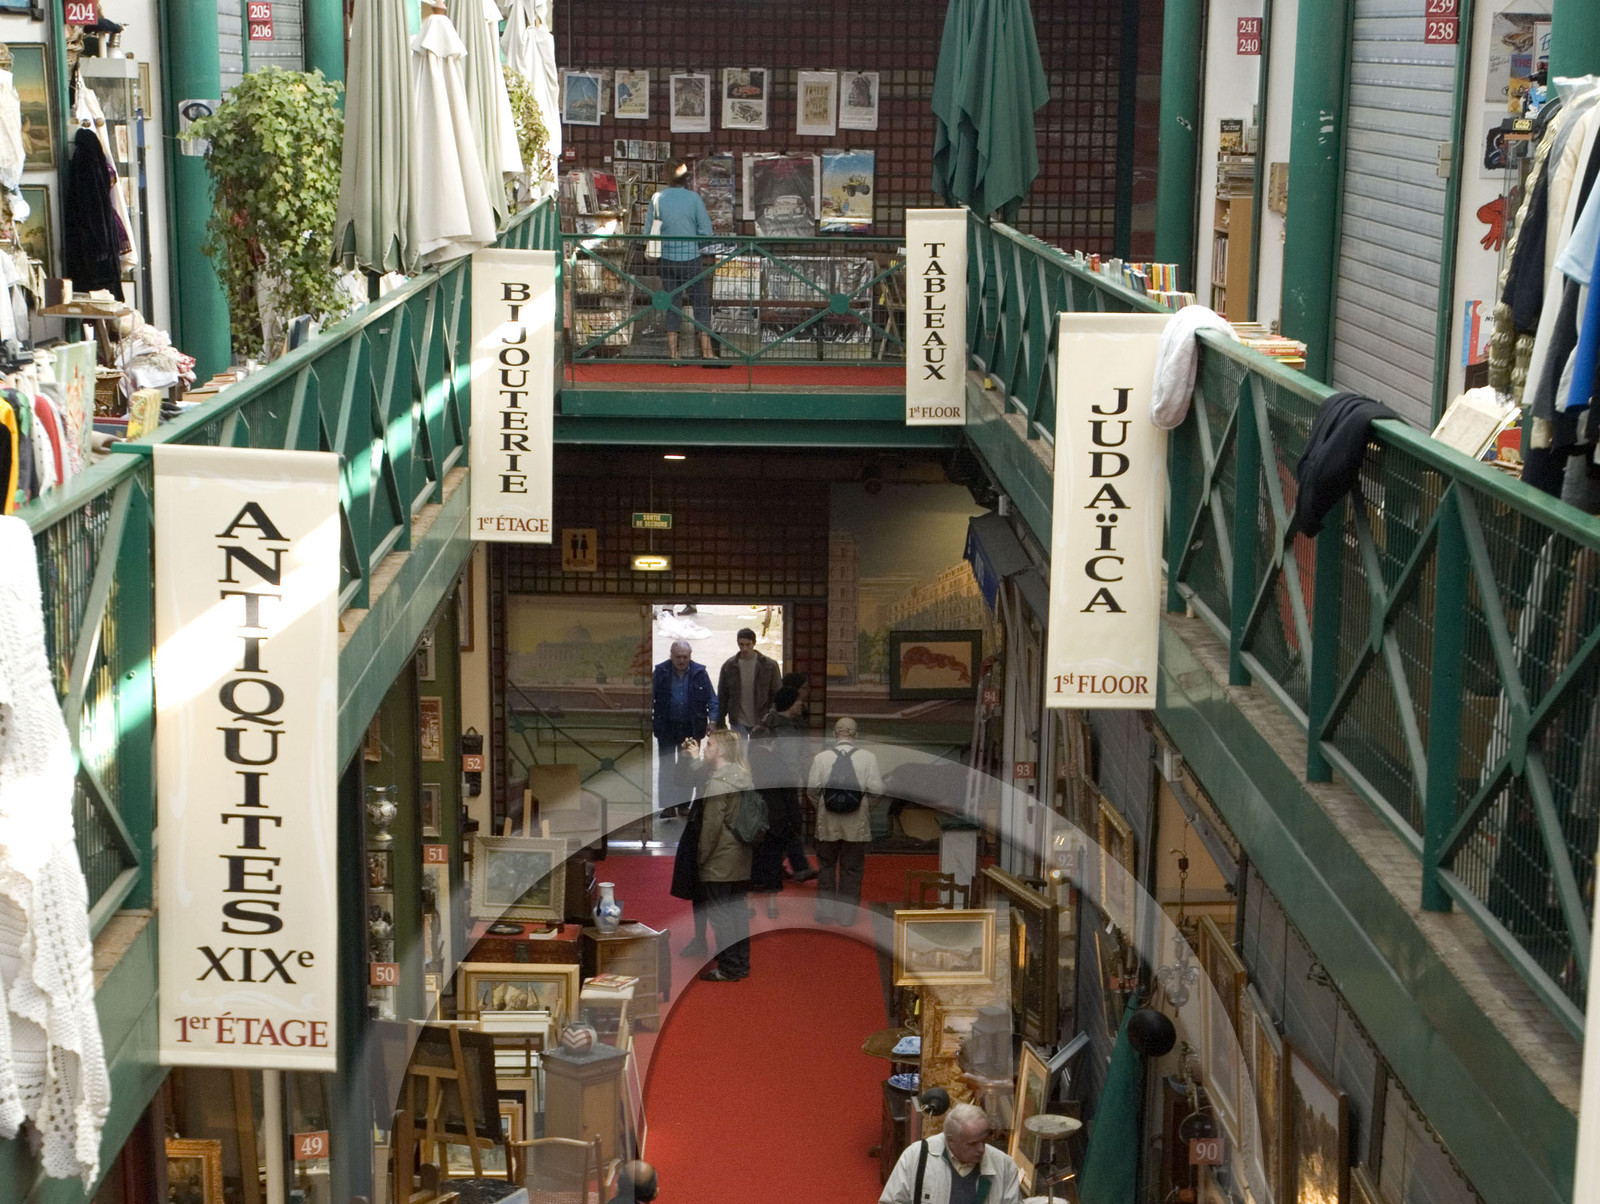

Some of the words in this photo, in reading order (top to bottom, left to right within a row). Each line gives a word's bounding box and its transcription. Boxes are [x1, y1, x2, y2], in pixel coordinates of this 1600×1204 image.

[68, 2, 95, 21] 204
[250, 5, 271, 19] 205
[1428, 0, 1454, 13] 239
[252, 24, 272, 38] 206
[1239, 20, 1258, 33] 241
[1427, 22, 1454, 40] 238
[1239, 39, 1258, 52] 240
[923, 242, 947, 381] TABLEAUX
[498, 281, 533, 494] BIJOUTERIE
[909, 406, 920, 418] 1st
[922, 407, 961, 418] FLOOR
[1080, 388, 1132, 614] JUDAÏCA
[477, 516, 494, 531] 1er
[496, 515, 549, 533] ÉTAGE
[1053, 672, 1075, 694] 1st
[1077, 675, 1149, 694] FLOOR
[984, 691, 996, 702] 94
[215, 501, 291, 936] ANTIQUITES
[466, 758, 481, 770] 52
[1016, 764, 1030, 776] 93
[428, 848, 443, 861] 51
[1058, 854, 1073, 866] 92
[196, 946, 315, 985] XIXe
[375, 967, 394, 983] 50
[174, 1015, 211, 1043] 1er
[214, 1011, 328, 1048] ÉTAGE
[301, 1137, 323, 1155] 49
[1196, 1142, 1218, 1160] 90
